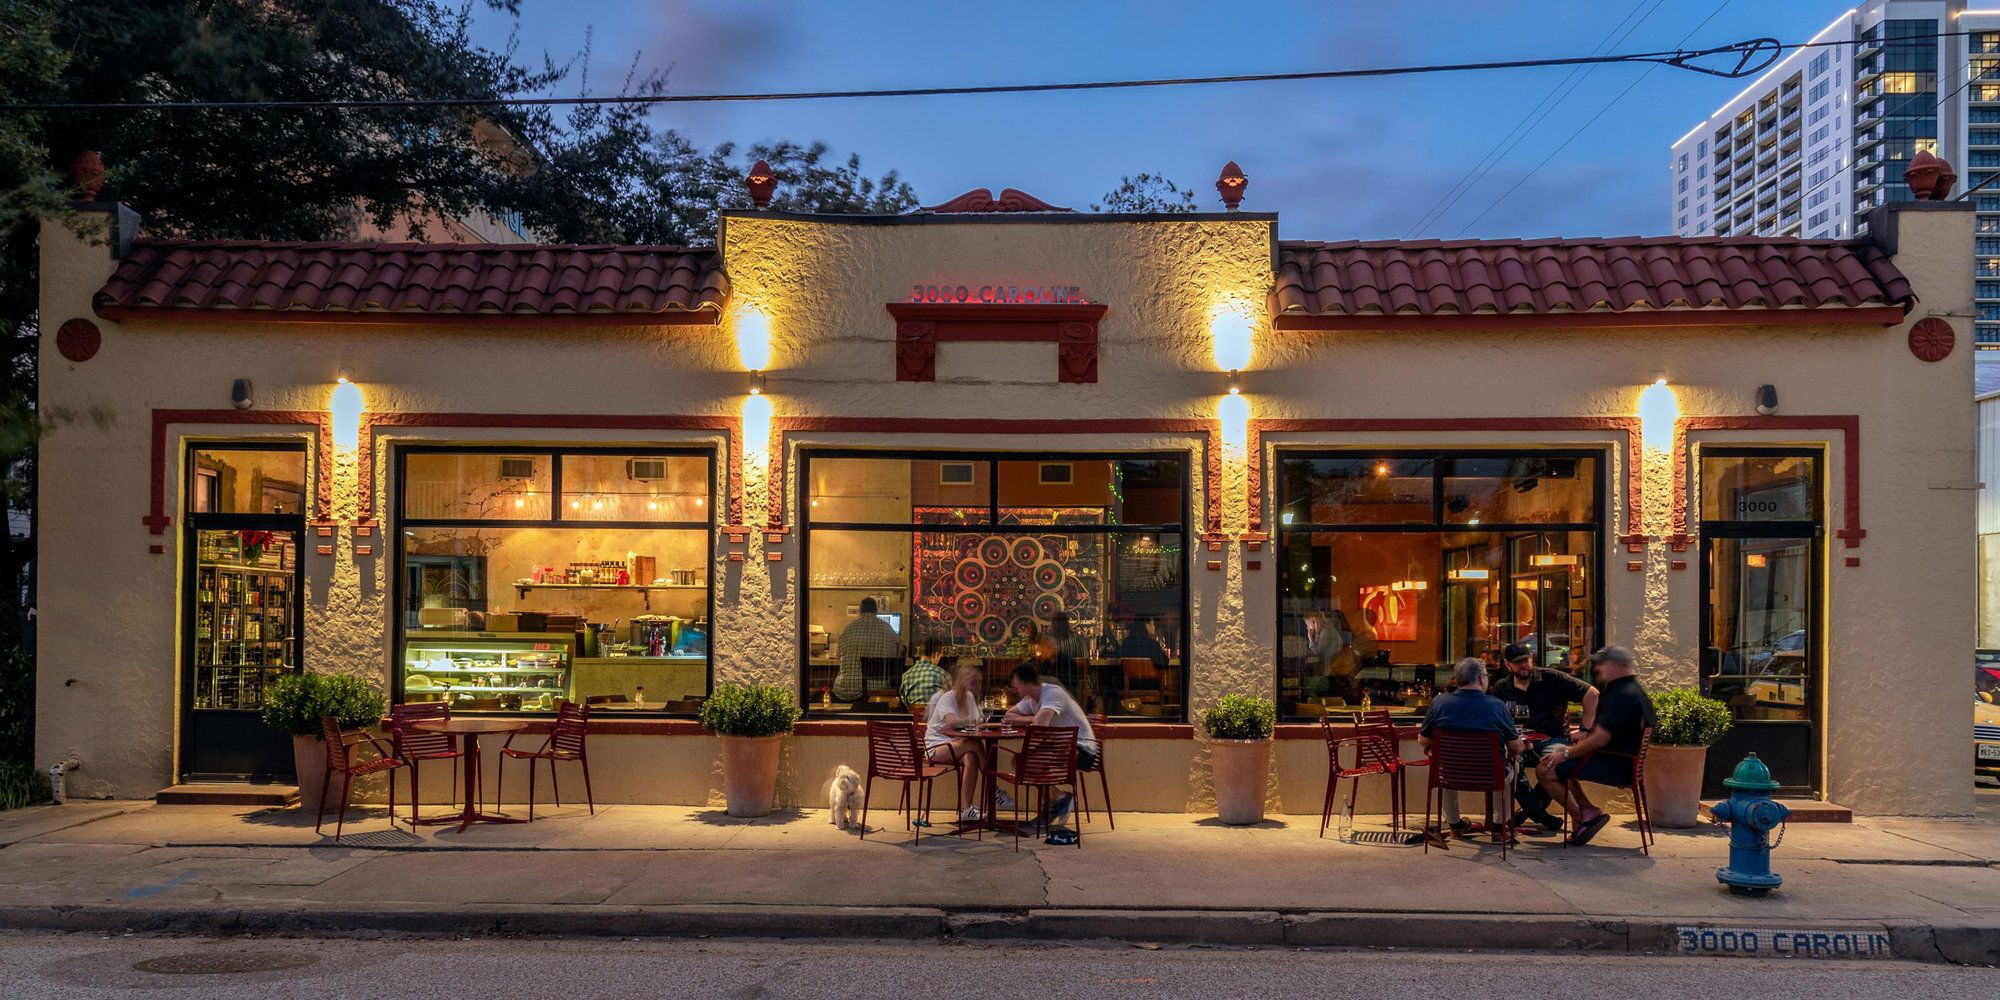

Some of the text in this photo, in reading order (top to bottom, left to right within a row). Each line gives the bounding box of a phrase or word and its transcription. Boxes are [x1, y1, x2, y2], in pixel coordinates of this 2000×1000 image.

[913, 285, 1081, 304] 3000 CAROLINE
[1739, 501, 1777, 512] 3000
[1680, 930, 1759, 953] 3000
